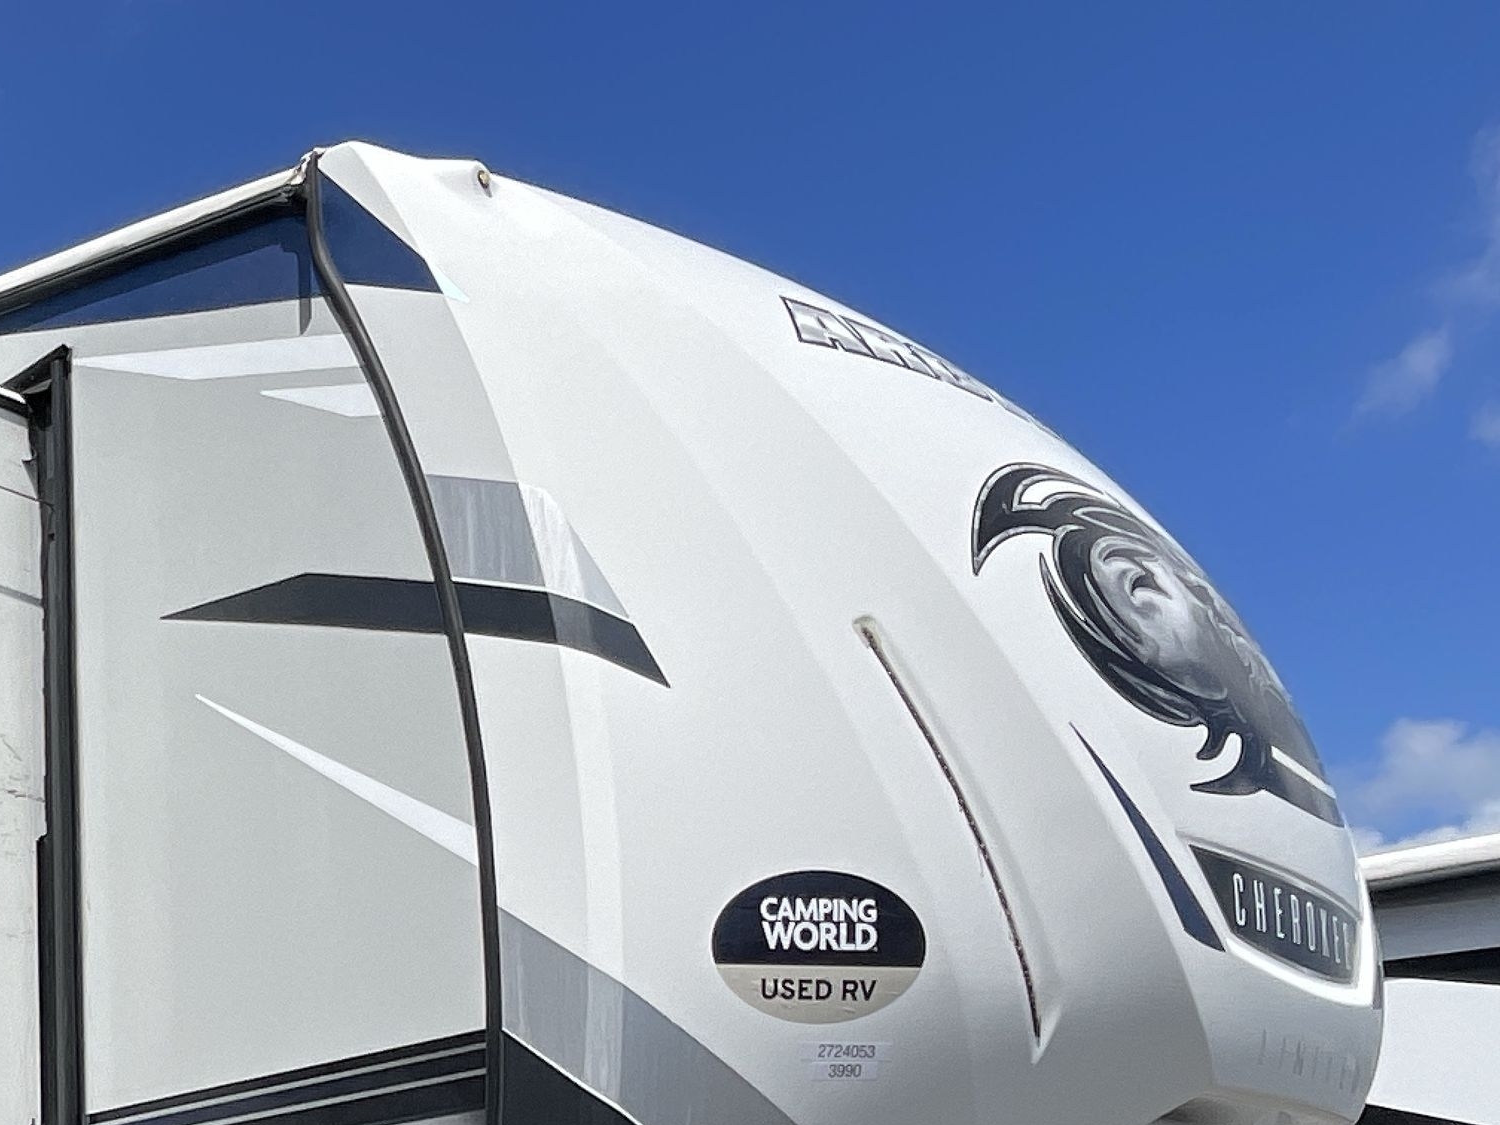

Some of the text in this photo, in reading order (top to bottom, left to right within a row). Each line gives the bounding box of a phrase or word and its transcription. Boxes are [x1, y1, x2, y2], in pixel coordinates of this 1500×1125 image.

[760, 897, 878, 923] CAMPING
[761, 921, 878, 951] WORLD
[761, 978, 877, 1001] USED RV
[817, 1044, 876, 1059] 2724053
[828, 1064, 862, 1079] 3990
